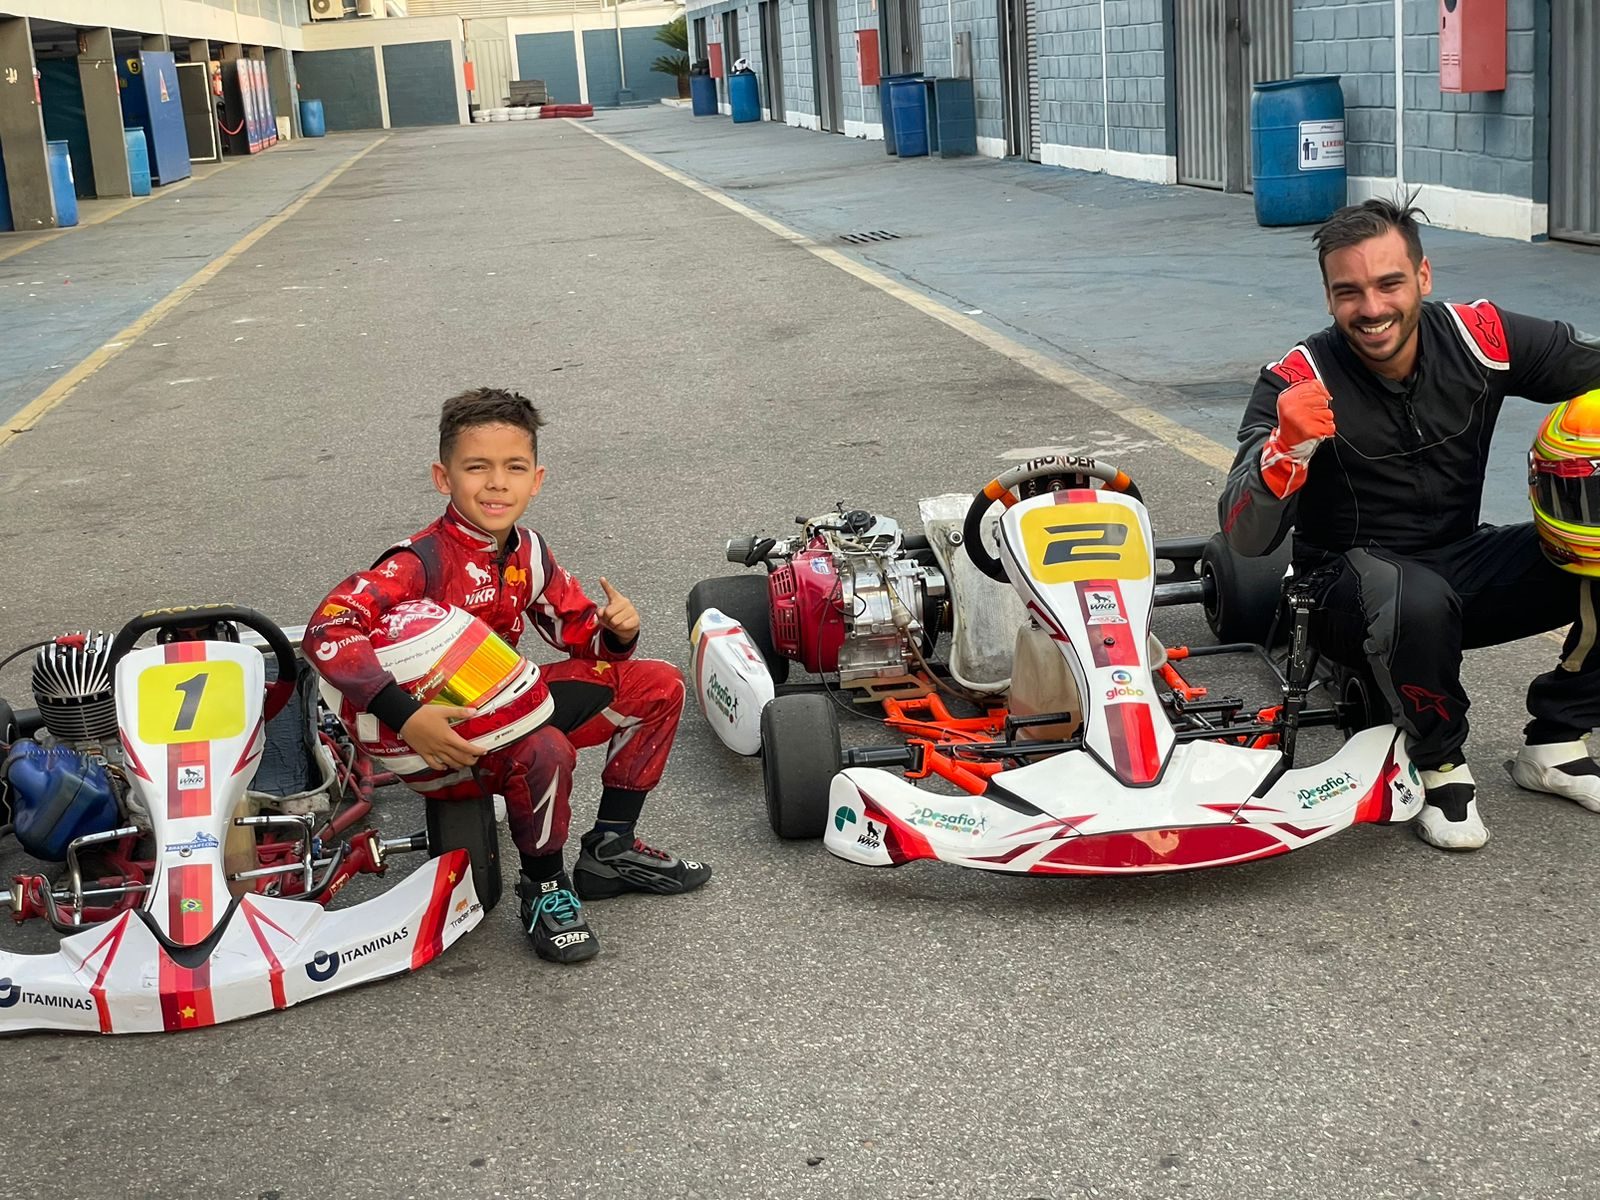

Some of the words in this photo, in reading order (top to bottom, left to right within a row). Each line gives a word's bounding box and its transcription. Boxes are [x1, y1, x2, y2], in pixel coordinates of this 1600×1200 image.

[130, 61, 139, 73] 9
[1042, 523, 1128, 565] 2
[464, 587, 496, 607] WKR
[1090, 603, 1116, 611] WKR
[173, 673, 209, 731] 1
[1105, 686, 1144, 700] globo
[1300, 777, 1345, 800] Desafio
[921, 807, 976, 826] Desafio
[857, 834, 880, 850] WKR
[341, 926, 409, 964] ITAMINAS
[554, 933, 590, 946] OMP
[22, 992, 92, 1010] ITAMINAS
